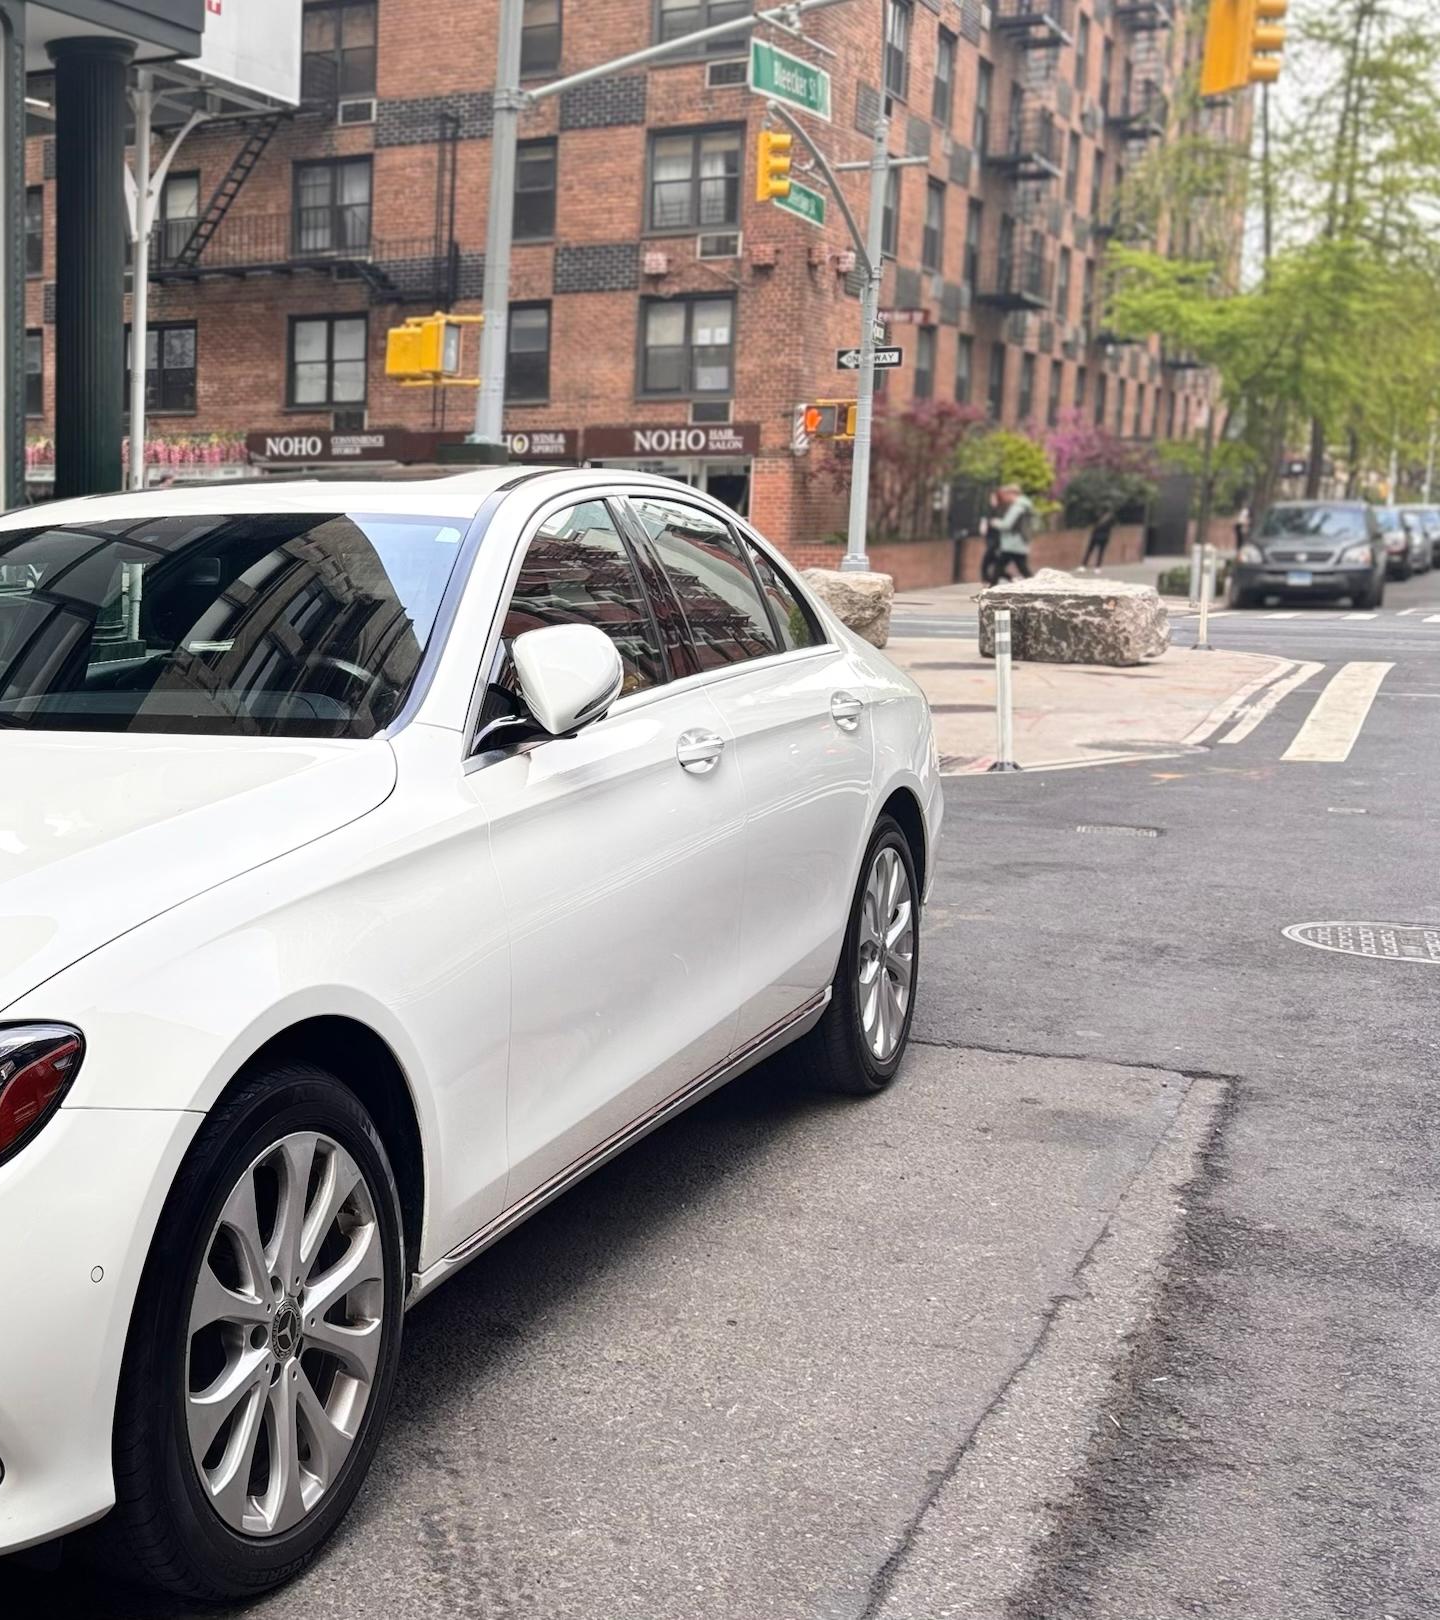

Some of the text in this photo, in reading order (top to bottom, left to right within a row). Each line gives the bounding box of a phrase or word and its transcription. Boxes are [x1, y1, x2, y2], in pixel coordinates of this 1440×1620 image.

[633, 429, 706, 452] NOHO
[709, 428, 734, 438] HAIR
[265, 436, 322, 456] NOHO
[709, 440, 743, 449] SALON
